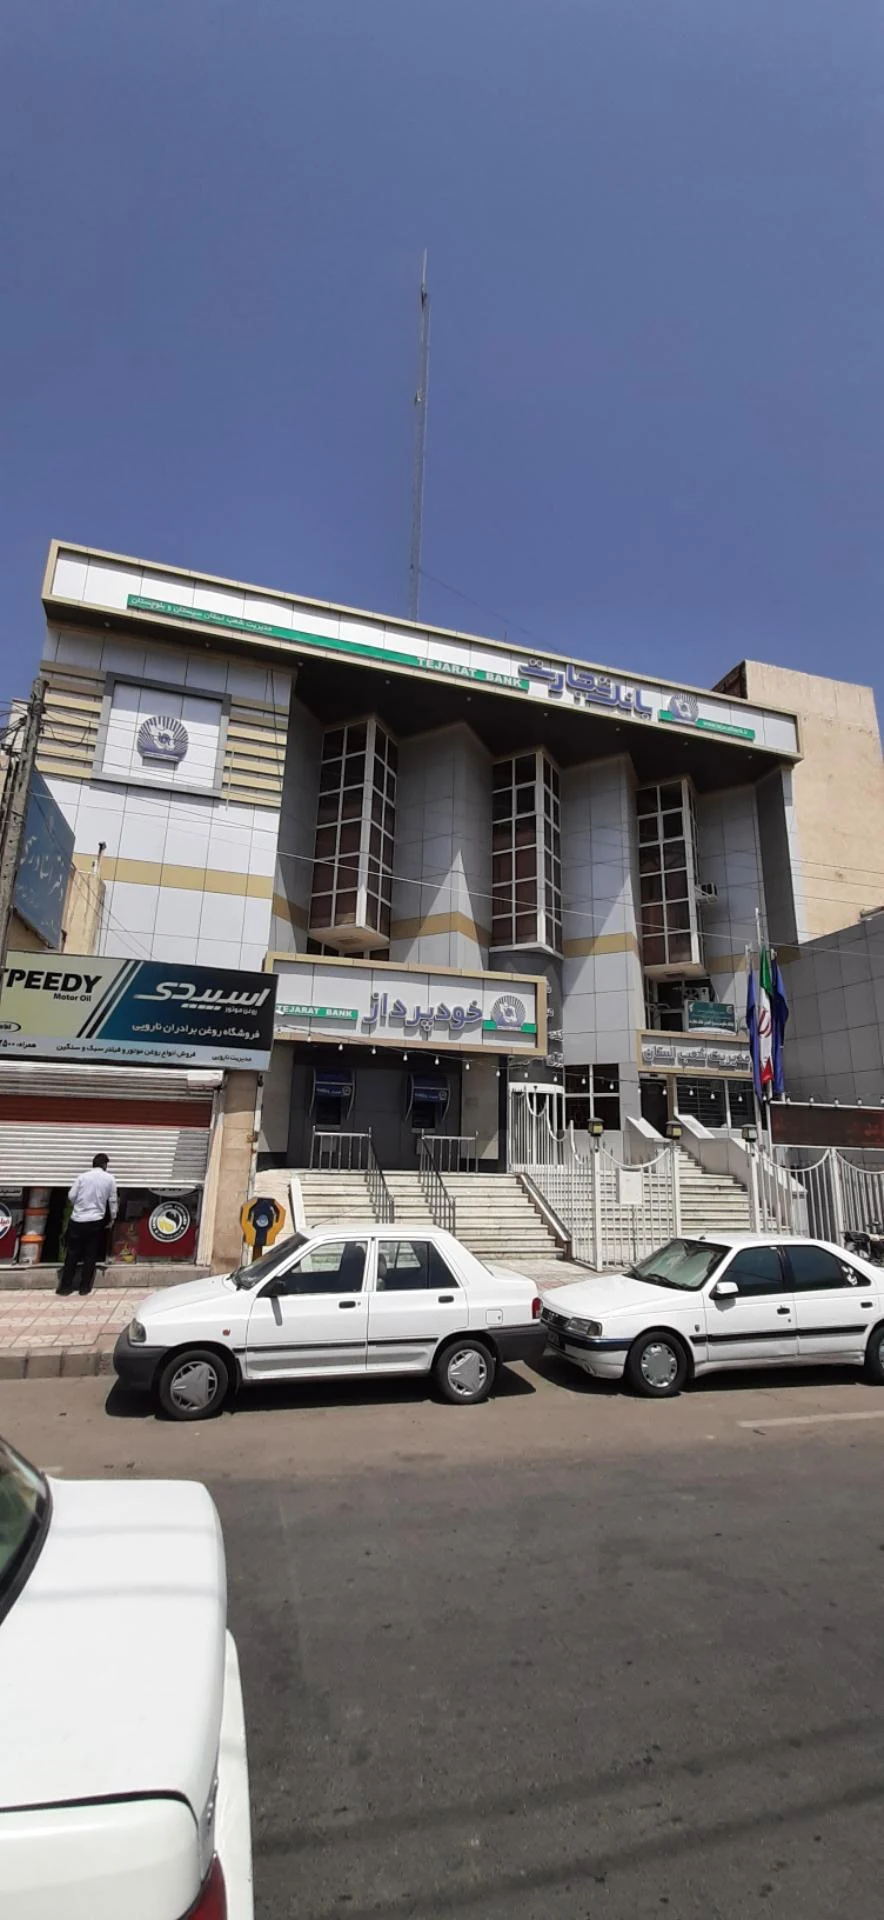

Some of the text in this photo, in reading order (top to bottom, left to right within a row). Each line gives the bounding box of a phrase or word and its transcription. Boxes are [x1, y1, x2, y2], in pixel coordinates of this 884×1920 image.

[130, 597, 165, 612] بلوچستان
[172, 606, 203, 619] سیستان
[417, 657, 523, 687] TEJARAT BANK
[518, 658, 653, 721] بانک تجارت
[53, 993, 78, 1001] Motor
[133, 982, 271, 1011] اسپیدی
[225, 1006, 258, 1016] روغن موتور
[276, 1004, 353, 1017] TEJARAT BANK
[361, 991, 483, 1030] خودپرداز
[163, 1024, 197, 1034] برادران
[198, 1027, 222, 1038] روغن
[223, 1029, 260, 1040] فروشگاه
[56, 1043, 81, 1051] سنگین
[144, 1049, 161, 1057] روغن
[161, 1049, 176, 1058] انواع
[177, 1050, 196, 1058] فروش
[677, 1046, 707, 1064] شعب
[707, 1050, 751, 1066] مدیریت
